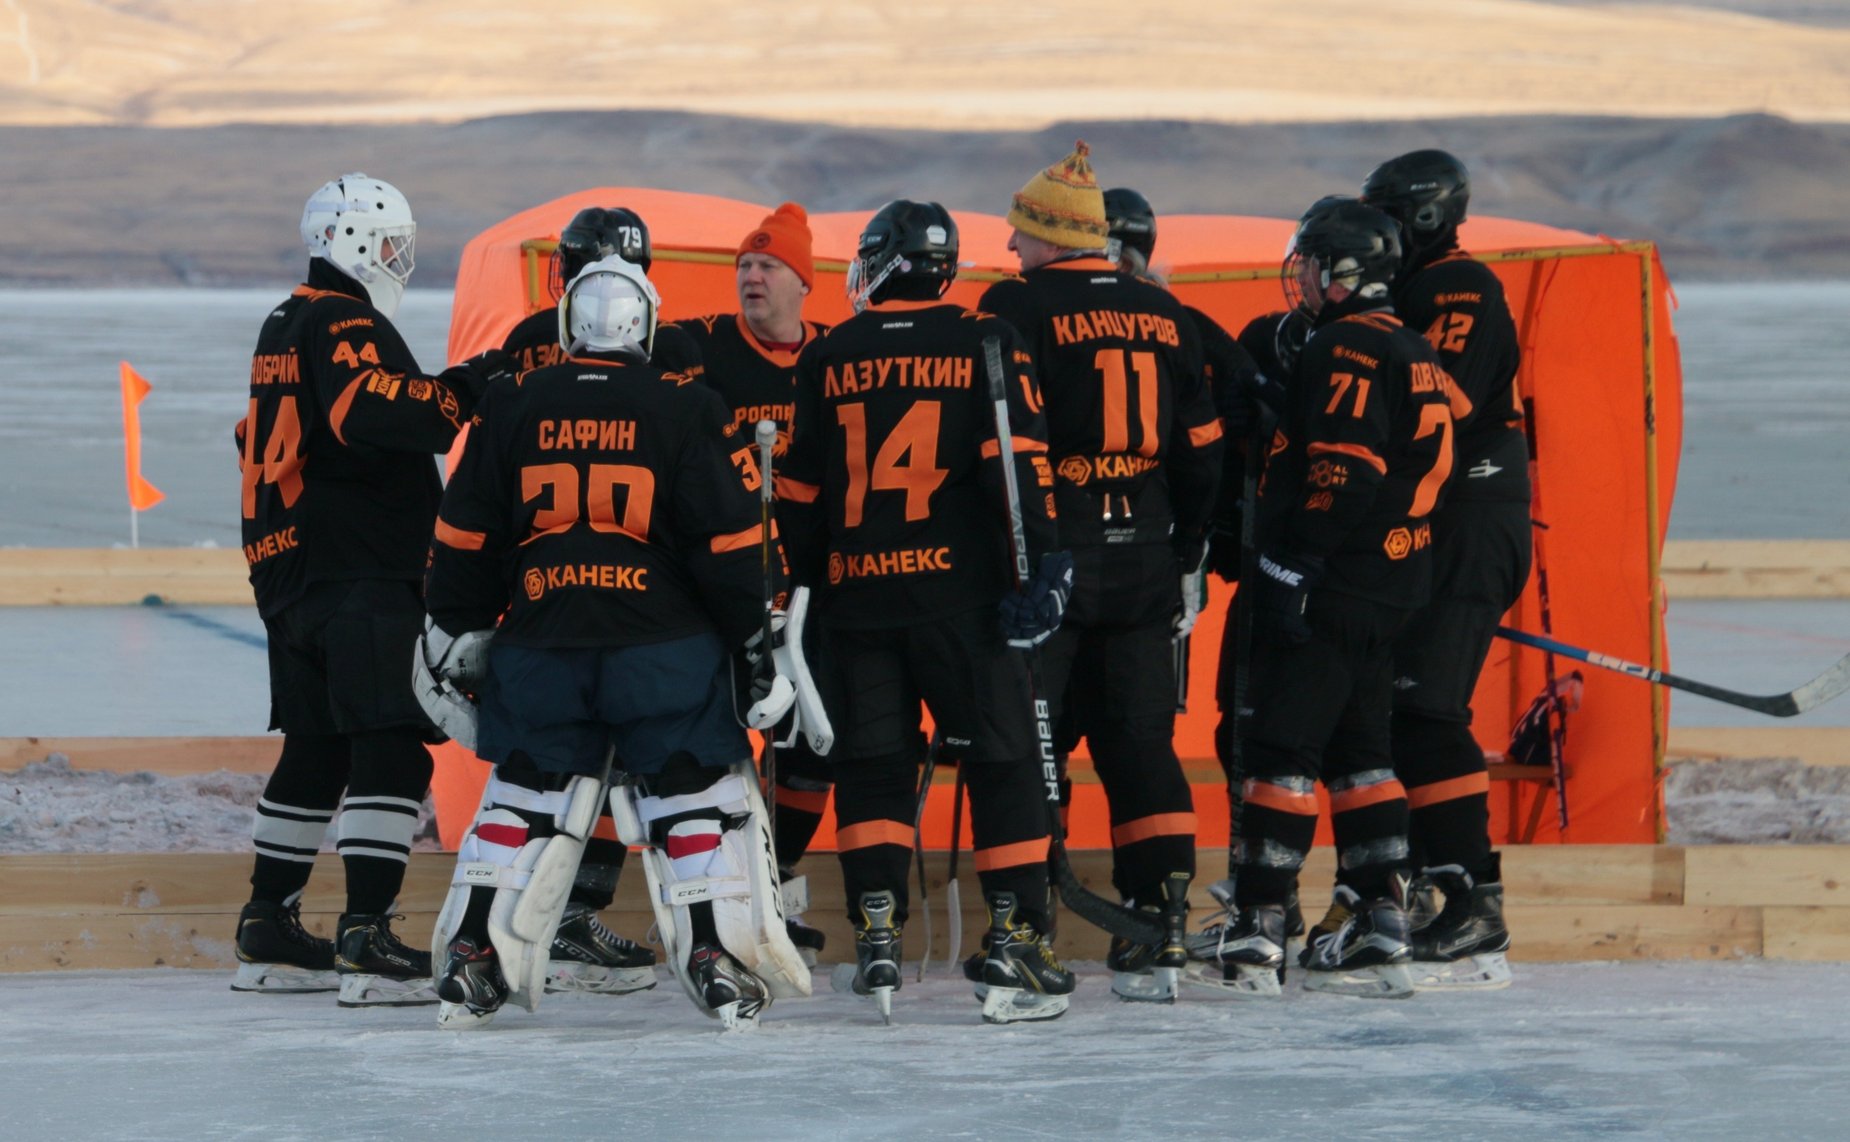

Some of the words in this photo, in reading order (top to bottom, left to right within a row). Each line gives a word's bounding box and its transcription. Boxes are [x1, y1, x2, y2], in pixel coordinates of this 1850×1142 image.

[618, 226, 643, 249] 79
[1447, 292, 1482, 303] КАНЕКС
[340, 318, 374, 329] КАНЕКС
[1052, 310, 1180, 347] КАНЦУРОВ
[1425, 312, 1474, 353] 42
[332, 340, 381, 369] 44
[1344, 348, 1379, 370] КАНЕКС
[825, 356, 974, 399] ЛАЗУТКИН
[1095, 348, 1160, 458] 11
[1325, 372, 1372, 419] 71
[538, 419, 637, 451] САФИН
[837, 401, 950, 528] 14
[547, 564, 648, 591] КАНЕКС
[847, 546, 952, 579] КАНЕКС
[1034, 699, 1060, 801] BAUER
[467, 869, 493, 877] CCM
[678, 887, 708, 898] CCM
[867, 898, 889, 906] CCM
